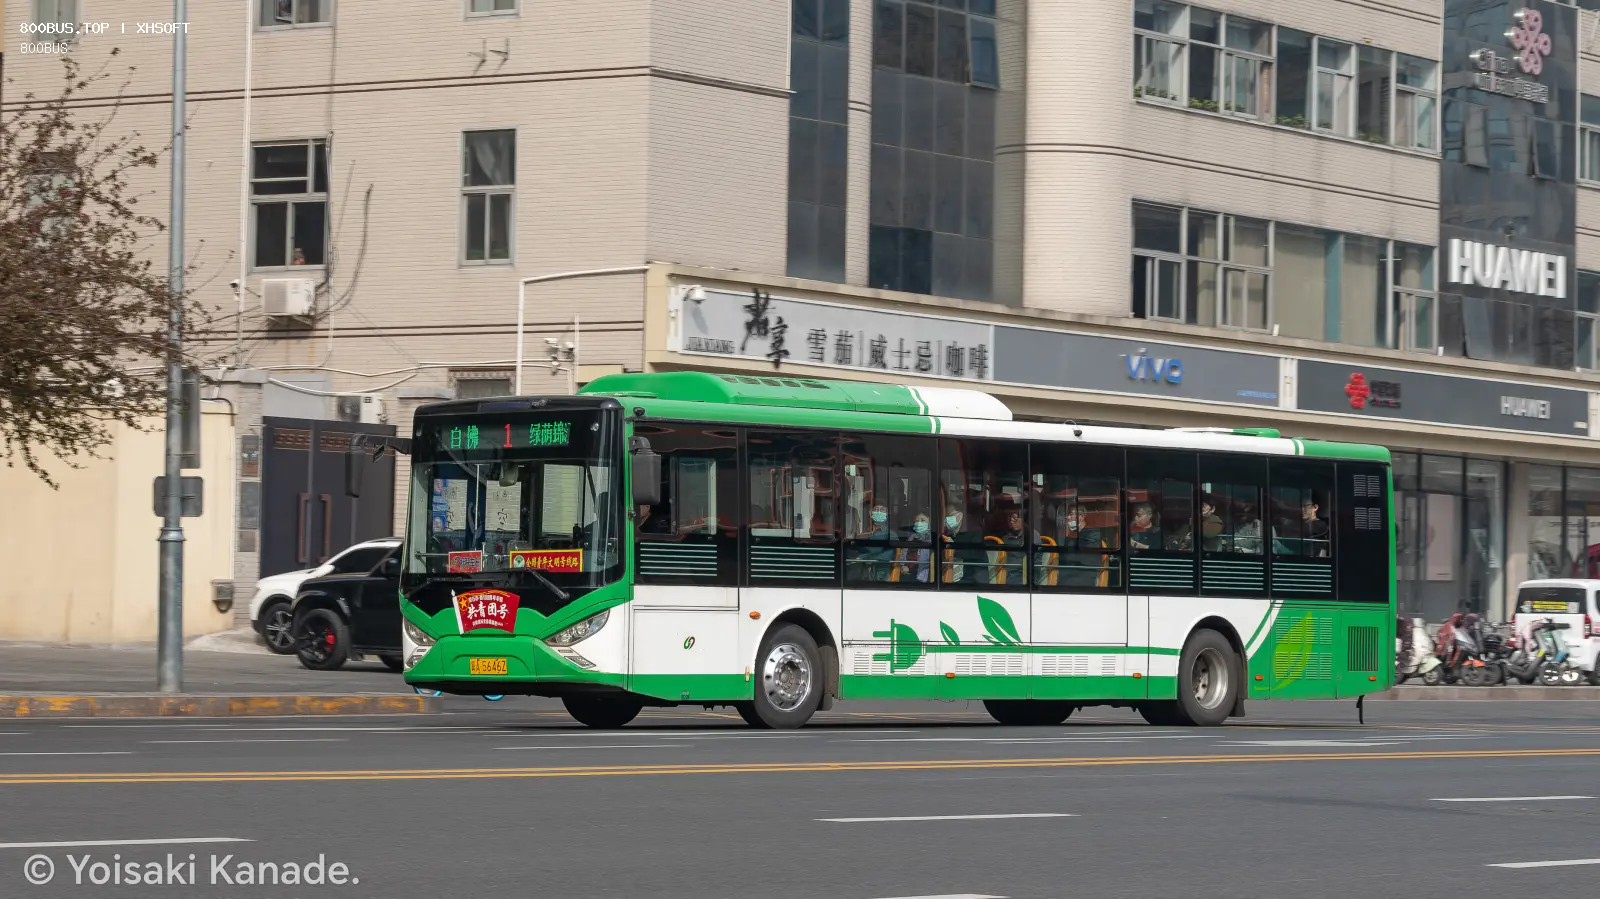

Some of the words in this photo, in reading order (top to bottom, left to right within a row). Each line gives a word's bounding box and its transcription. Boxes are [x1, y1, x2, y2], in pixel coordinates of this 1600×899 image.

[1448, 238, 1567, 299] HUAWEI
[806, 327, 854, 365] 雪茄
[868, 333, 932, 372] 威士忌
[945, 340, 989, 379] 咖啡
[1120, 348, 1184, 384] vivo
[1501, 395, 1550, 419] HUAWEI
[503, 423, 513, 448] 1
[467, 600, 509, 620] 共青团号
